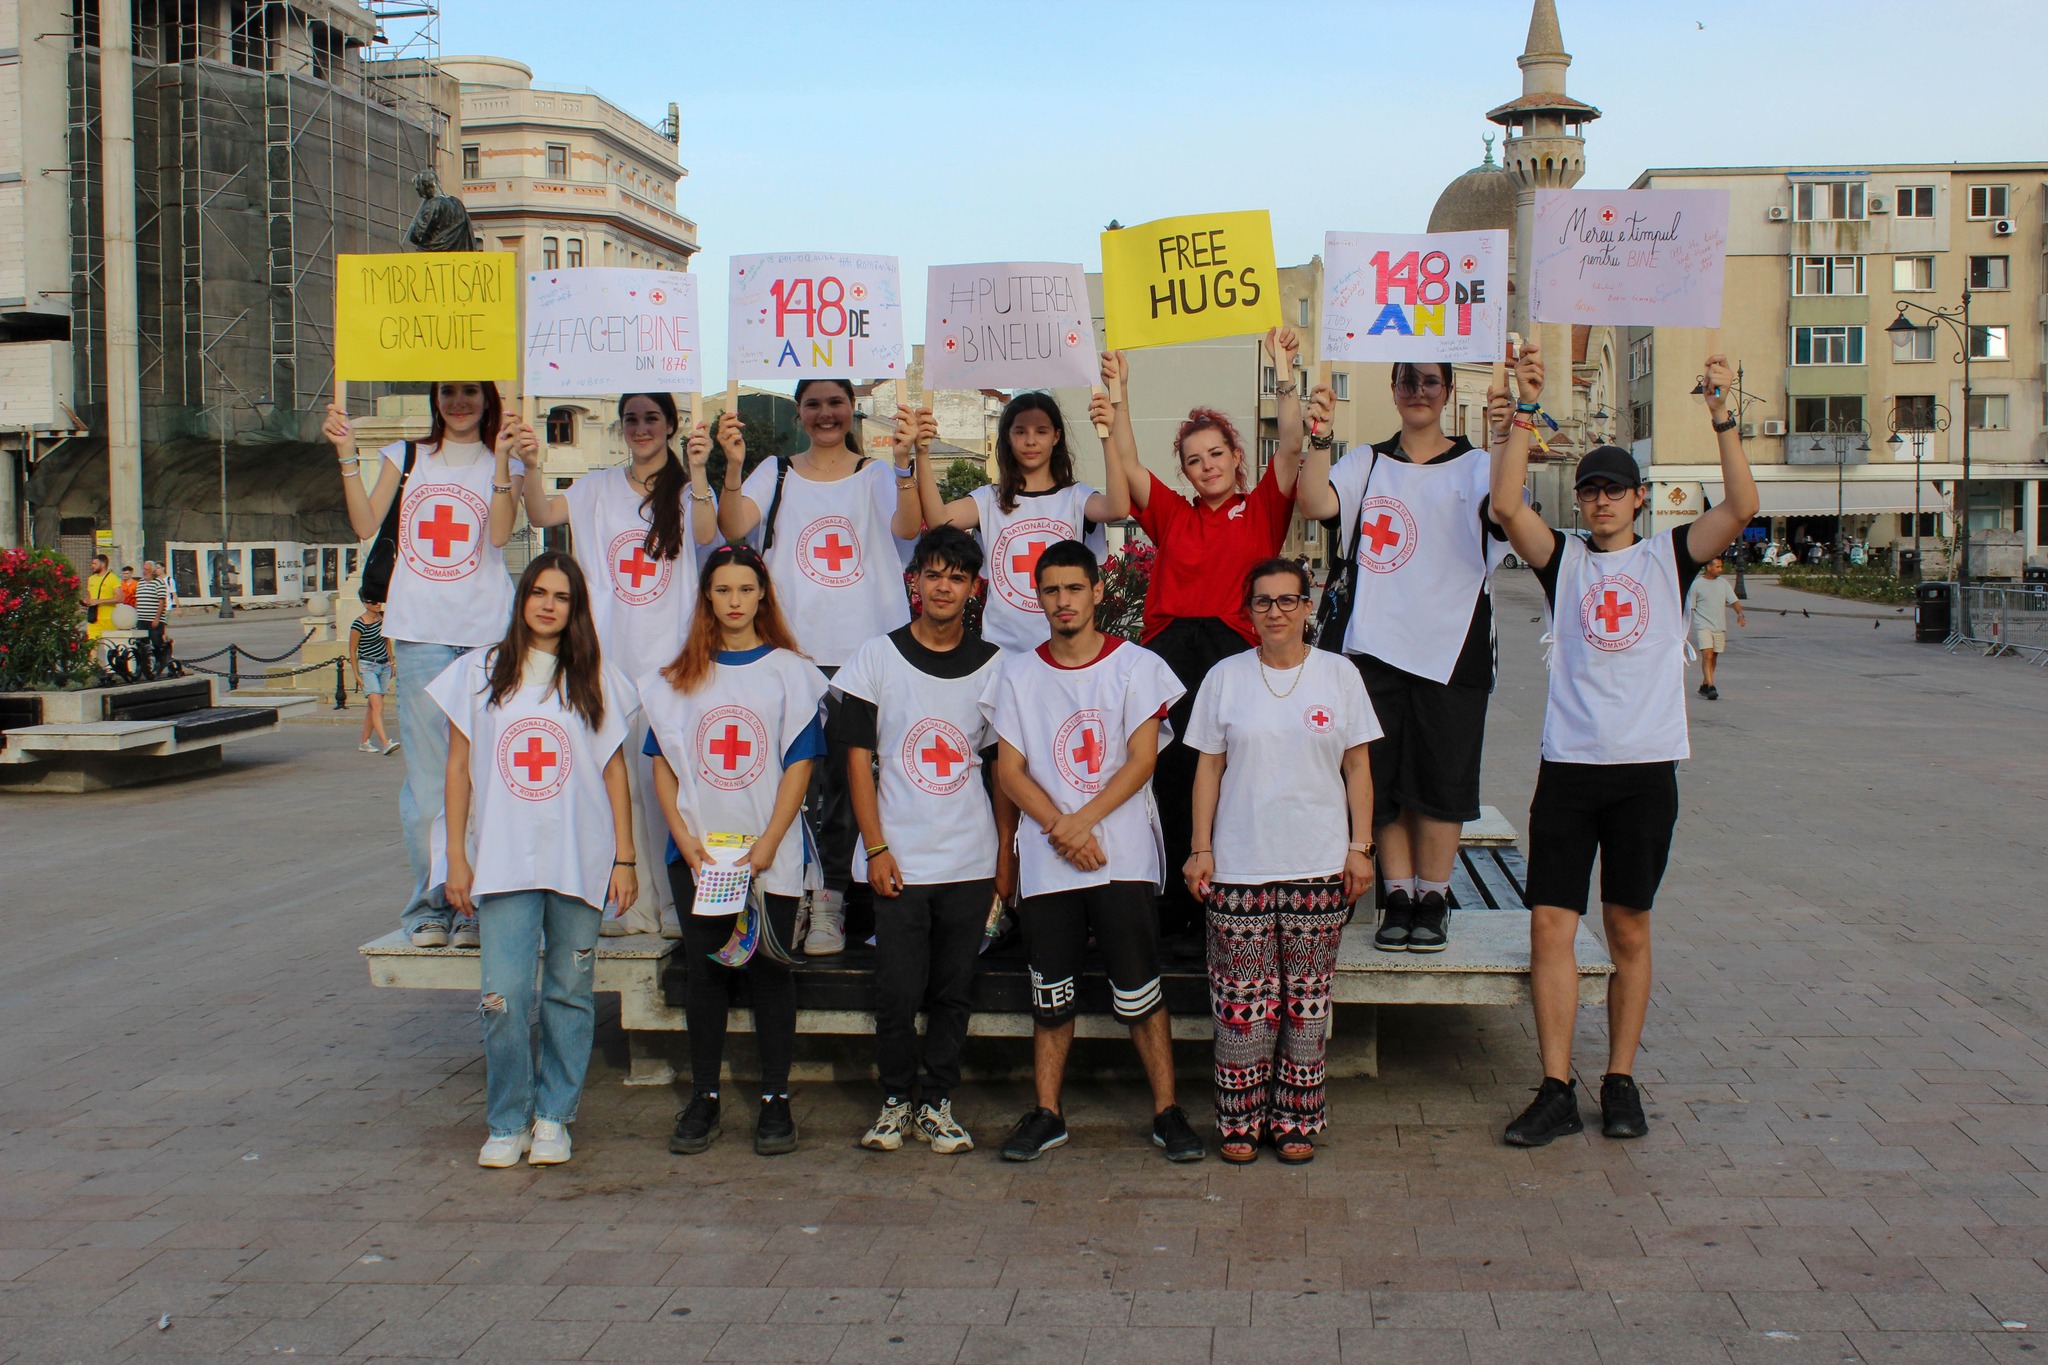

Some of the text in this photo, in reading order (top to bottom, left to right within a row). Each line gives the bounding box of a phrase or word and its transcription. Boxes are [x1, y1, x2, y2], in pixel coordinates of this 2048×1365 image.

[1158, 229, 1228, 273] FREE
[1559, 207, 1614, 244] Mereu
[1617, 231, 1626, 242] e
[1624, 210, 1681, 256] timpul
[1368, 250, 1450, 305] 148
[1455, 279, 1486, 304] DE
[1579, 244, 1621, 280] pentru
[1627, 250, 1662, 269] BINE
[769, 276, 847, 337] 148
[849, 309, 870, 338] DE
[949, 275, 1078, 315] #PUTEREA
[1149, 267, 1261, 319] HUGS
[379, 311, 486, 351] GRATUITE
[528, 313, 694, 358] #FACEMBINE
[962, 315, 1062, 363] BINELUI
[1366, 303, 1472, 336] ANI
[636, 355, 688, 372] DIN 1876
[777, 339, 854, 367] ANI
[463, 493, 476, 504] DE
[1400, 508, 1408, 517] DE
[1406, 518, 1414, 541] CRUCE
[995, 535, 1008, 587] SOCIETATEA
[1052, 523, 1066, 533] DE
[1624, 579, 1633, 587] DE
[744, 713, 753, 722] DE
[548, 724, 558, 733] DE
[557, 731, 570, 755] CRUCE
[905, 733, 917, 775] SOCIETATEA
[947, 728, 958, 736] DE
